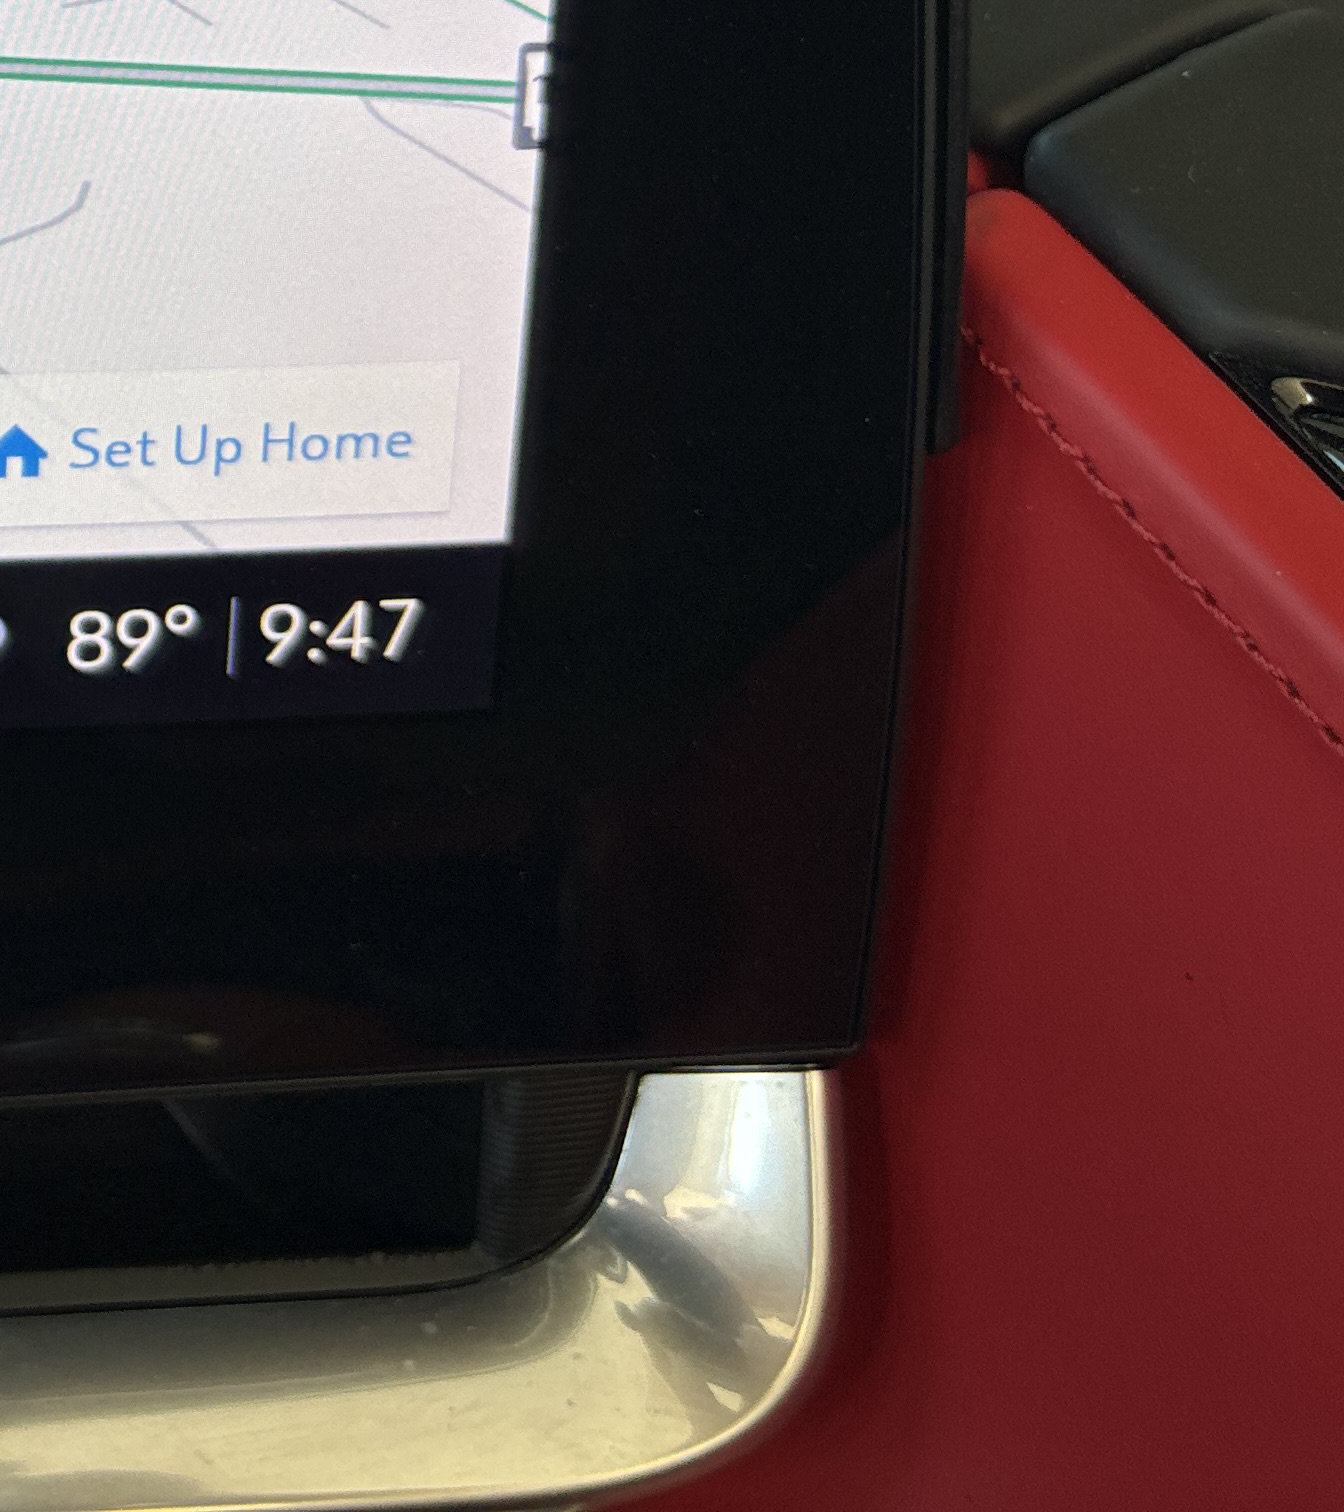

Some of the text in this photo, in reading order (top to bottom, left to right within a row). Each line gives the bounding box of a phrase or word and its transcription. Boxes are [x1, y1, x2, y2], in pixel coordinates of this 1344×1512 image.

[68, 420, 415, 478] Set Up Home
[66, 602, 200, 674] 89°
[259, 597, 425, 668] 9:47
